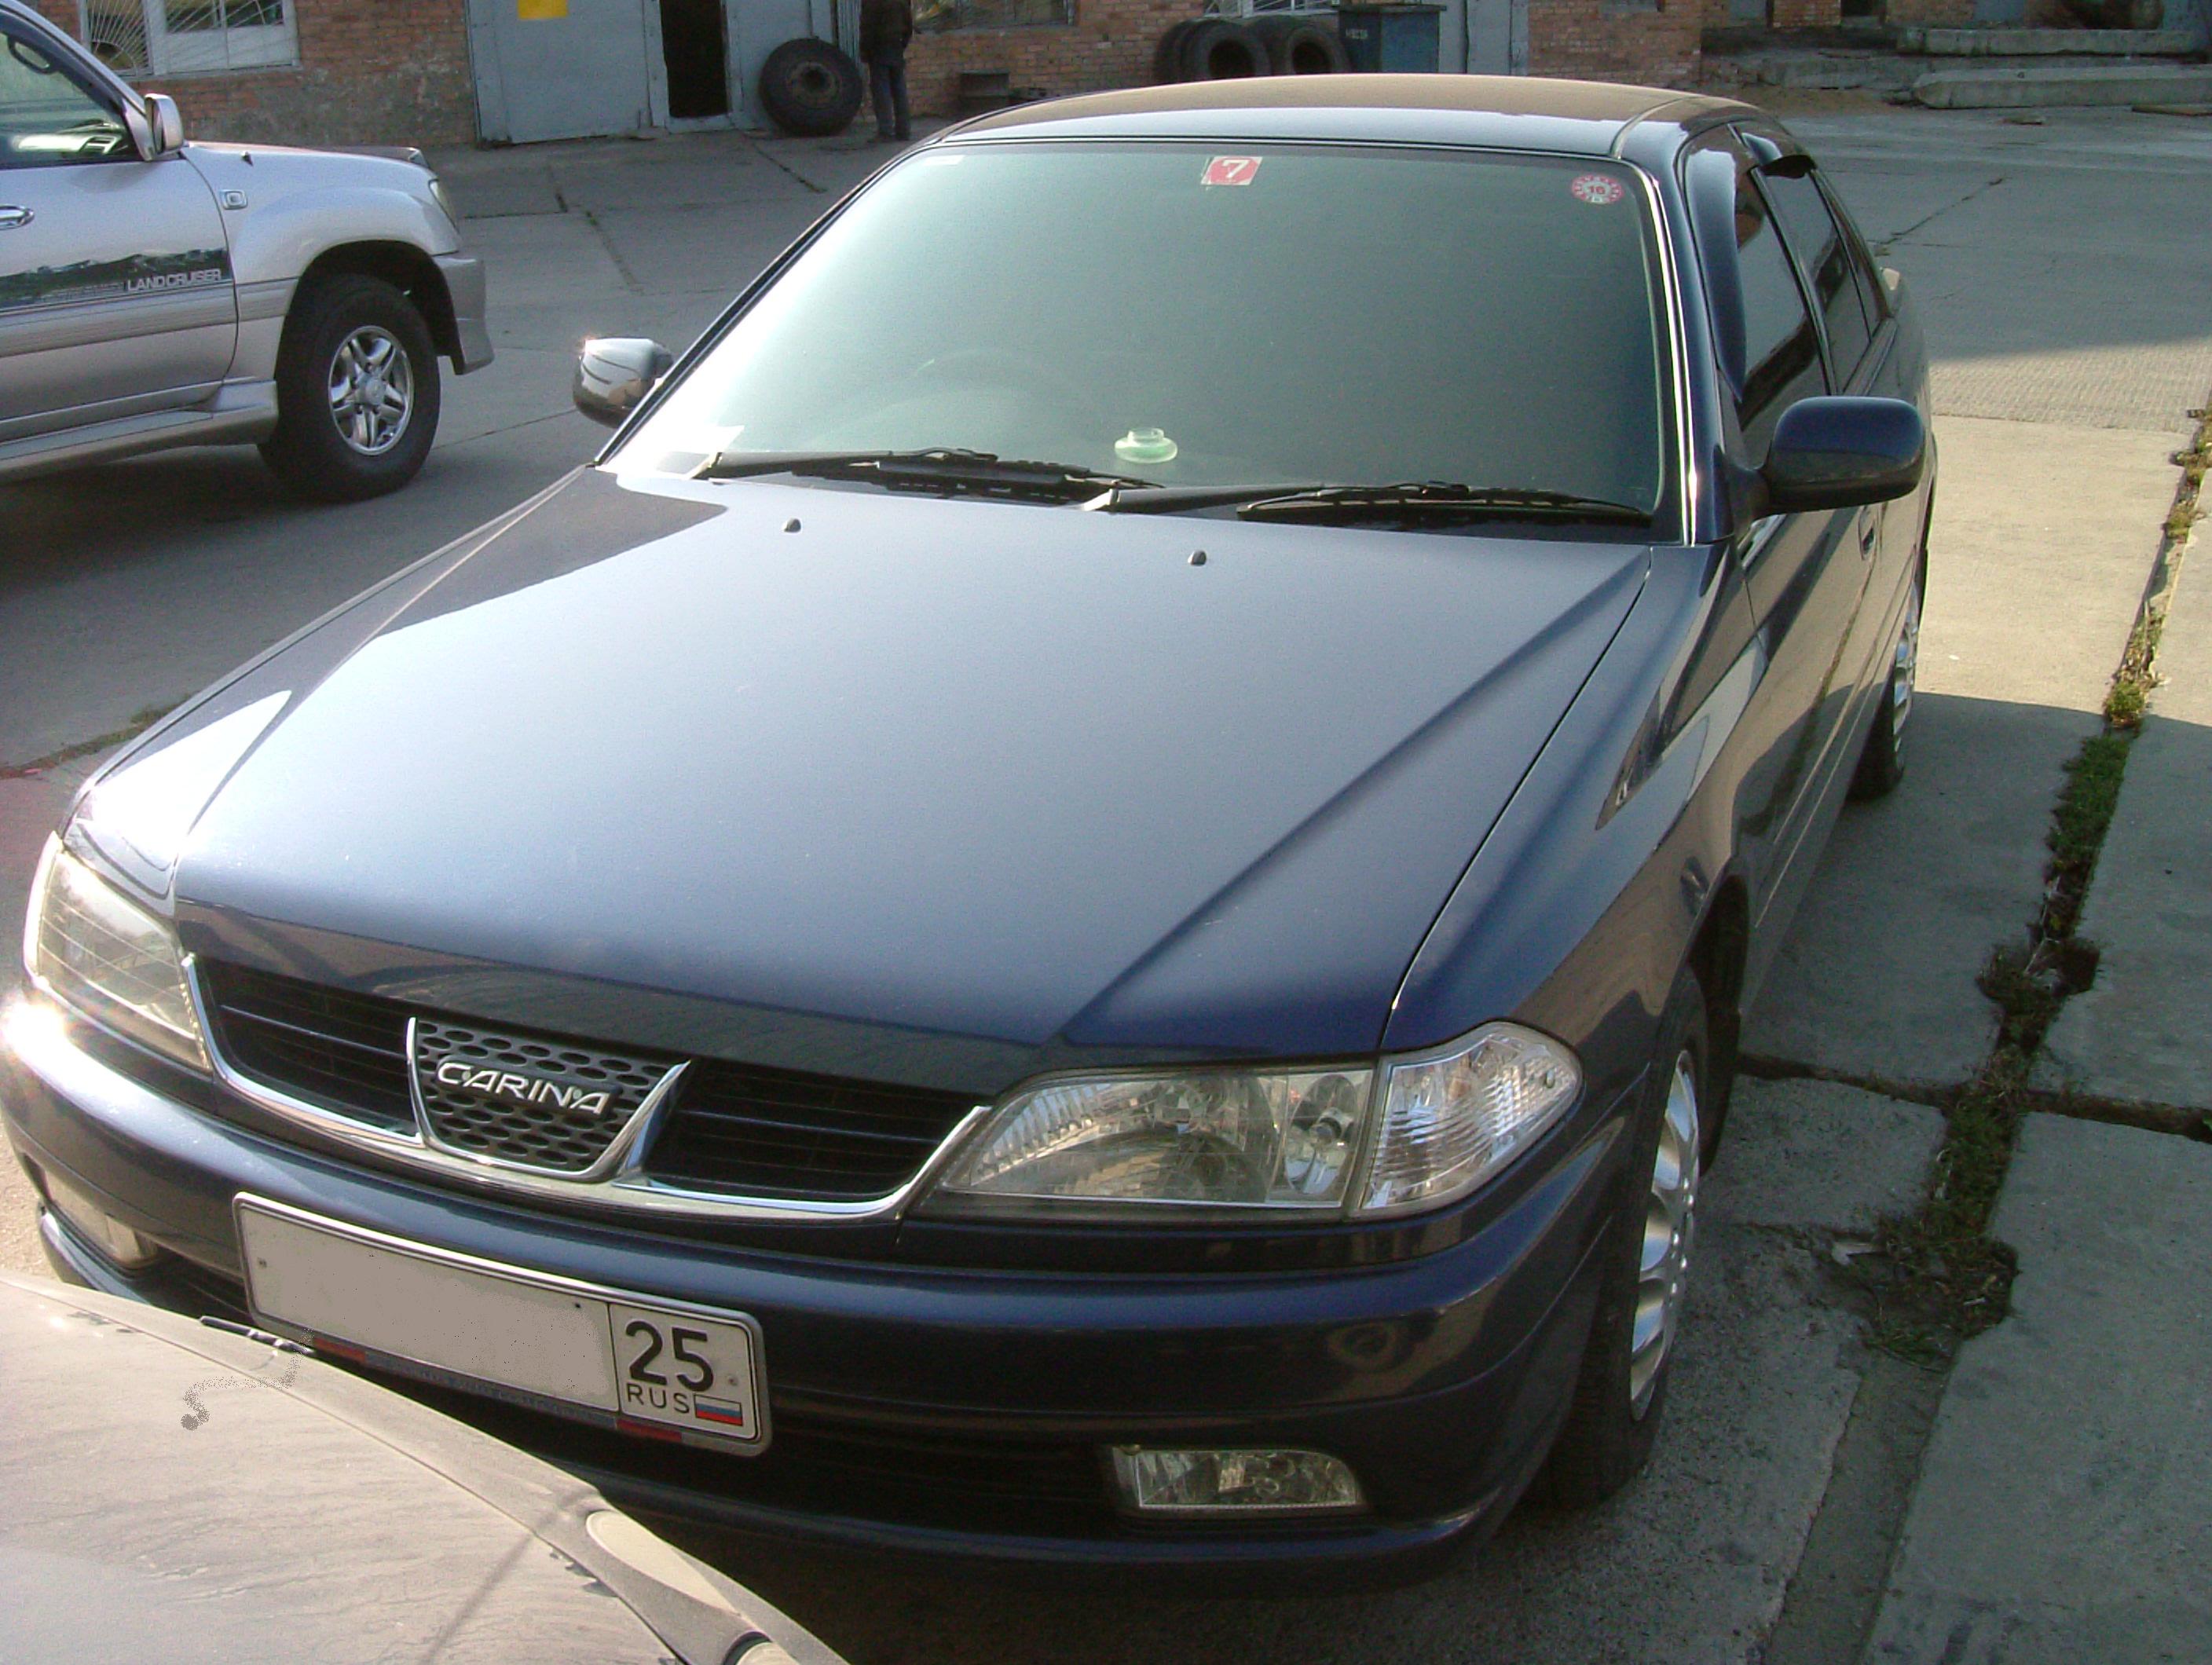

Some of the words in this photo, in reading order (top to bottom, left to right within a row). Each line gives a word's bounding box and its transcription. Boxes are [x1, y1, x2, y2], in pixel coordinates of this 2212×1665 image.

[1222, 159, 1251, 178] 7
[437, 1062, 611, 1115] CARINA
[625, 1319, 714, 1392] 25
[626, 1382, 690, 1414] RUS
